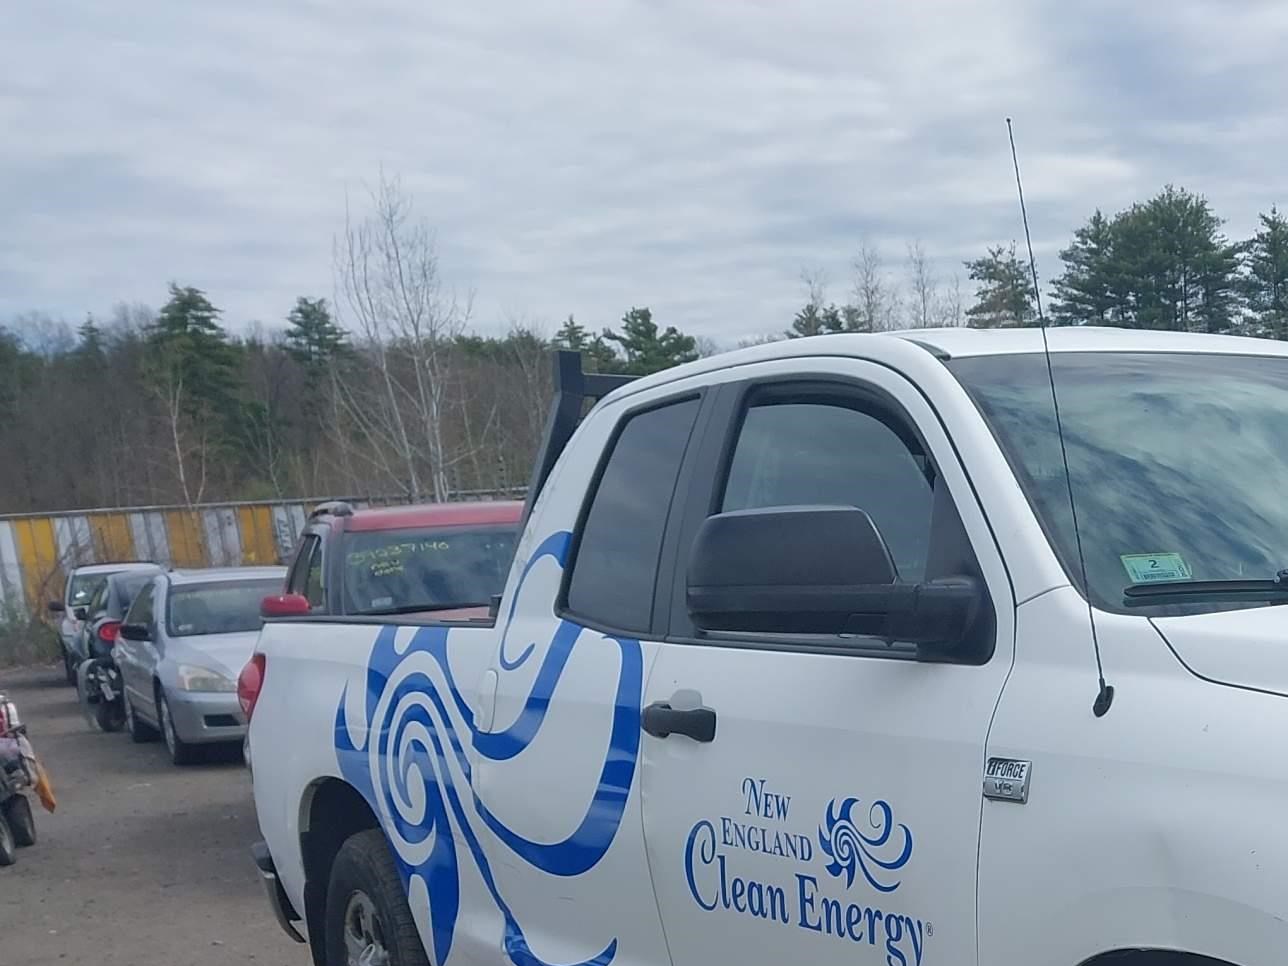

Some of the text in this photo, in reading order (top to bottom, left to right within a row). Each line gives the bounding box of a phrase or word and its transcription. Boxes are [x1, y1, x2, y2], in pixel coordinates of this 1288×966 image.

[1148, 559, 1160, 569] 2
[720, 816, 813, 862] ENGLAND
[684, 819, 789, 925] Clean
